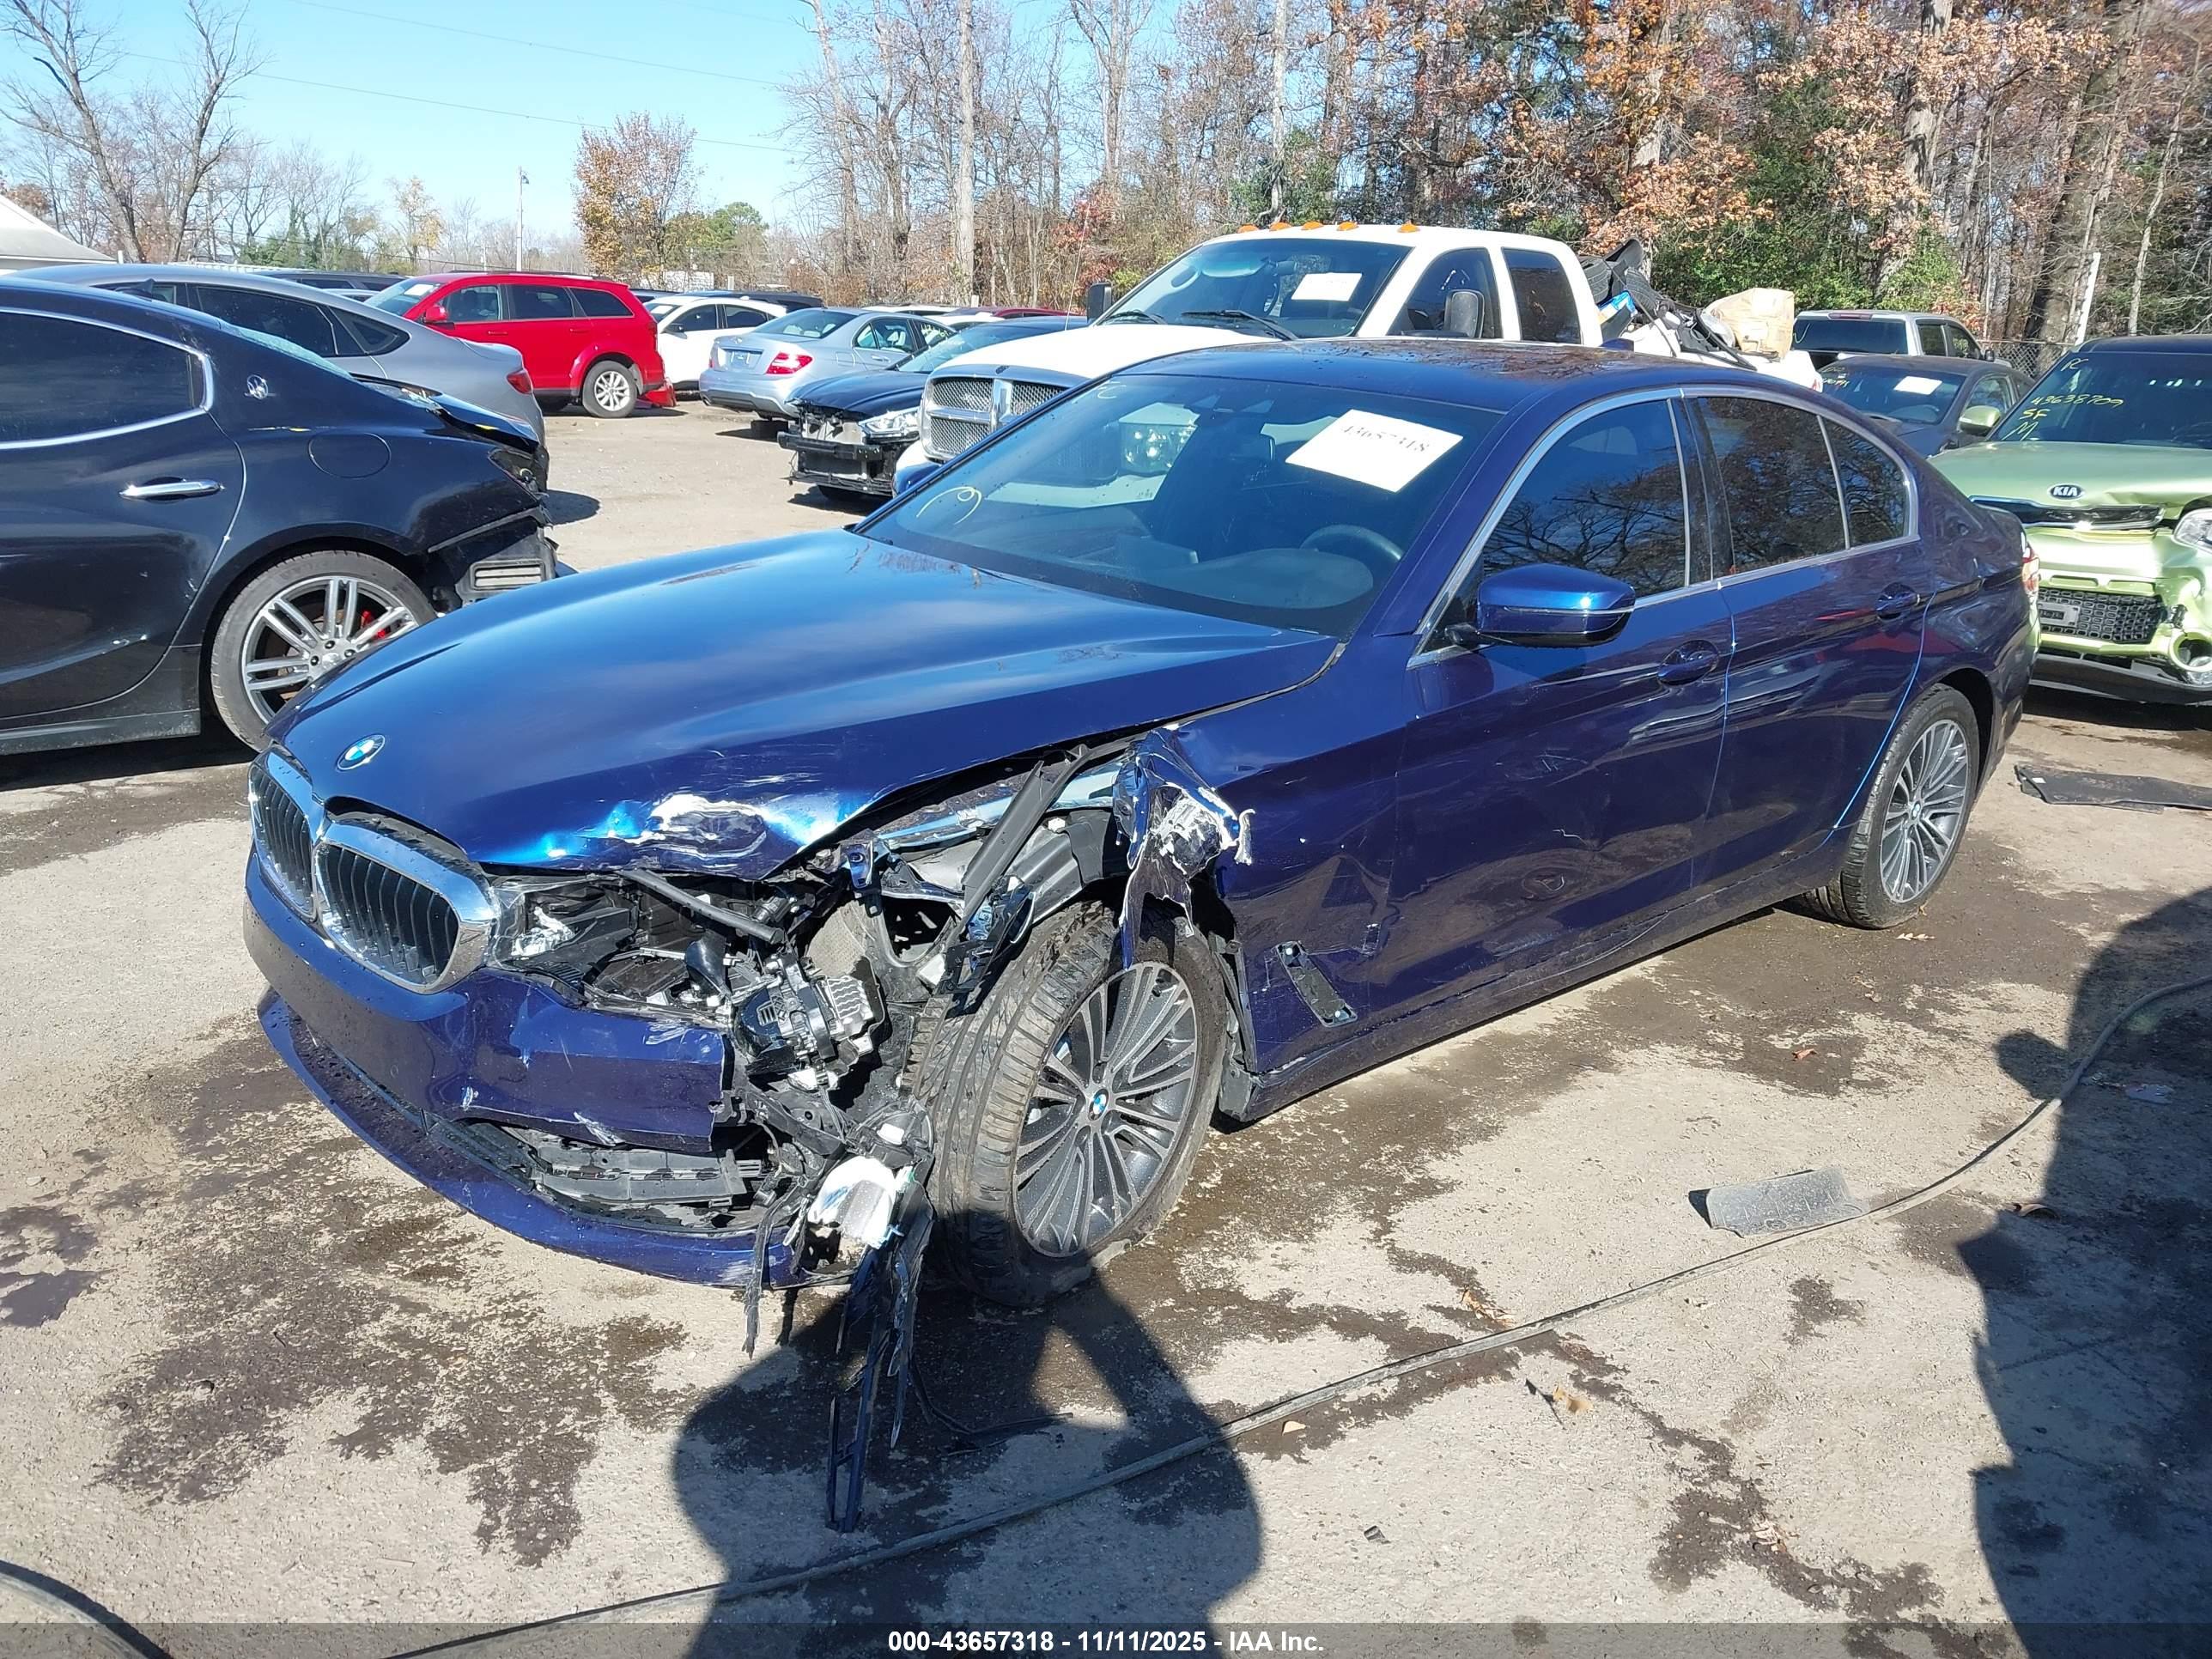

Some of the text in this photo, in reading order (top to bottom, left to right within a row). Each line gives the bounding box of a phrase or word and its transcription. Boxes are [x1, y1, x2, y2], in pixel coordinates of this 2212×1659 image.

[2031, 393, 2124, 408] 43638709
[2019, 408, 2051, 420] SF
[2052, 486, 2078, 496] KIA
